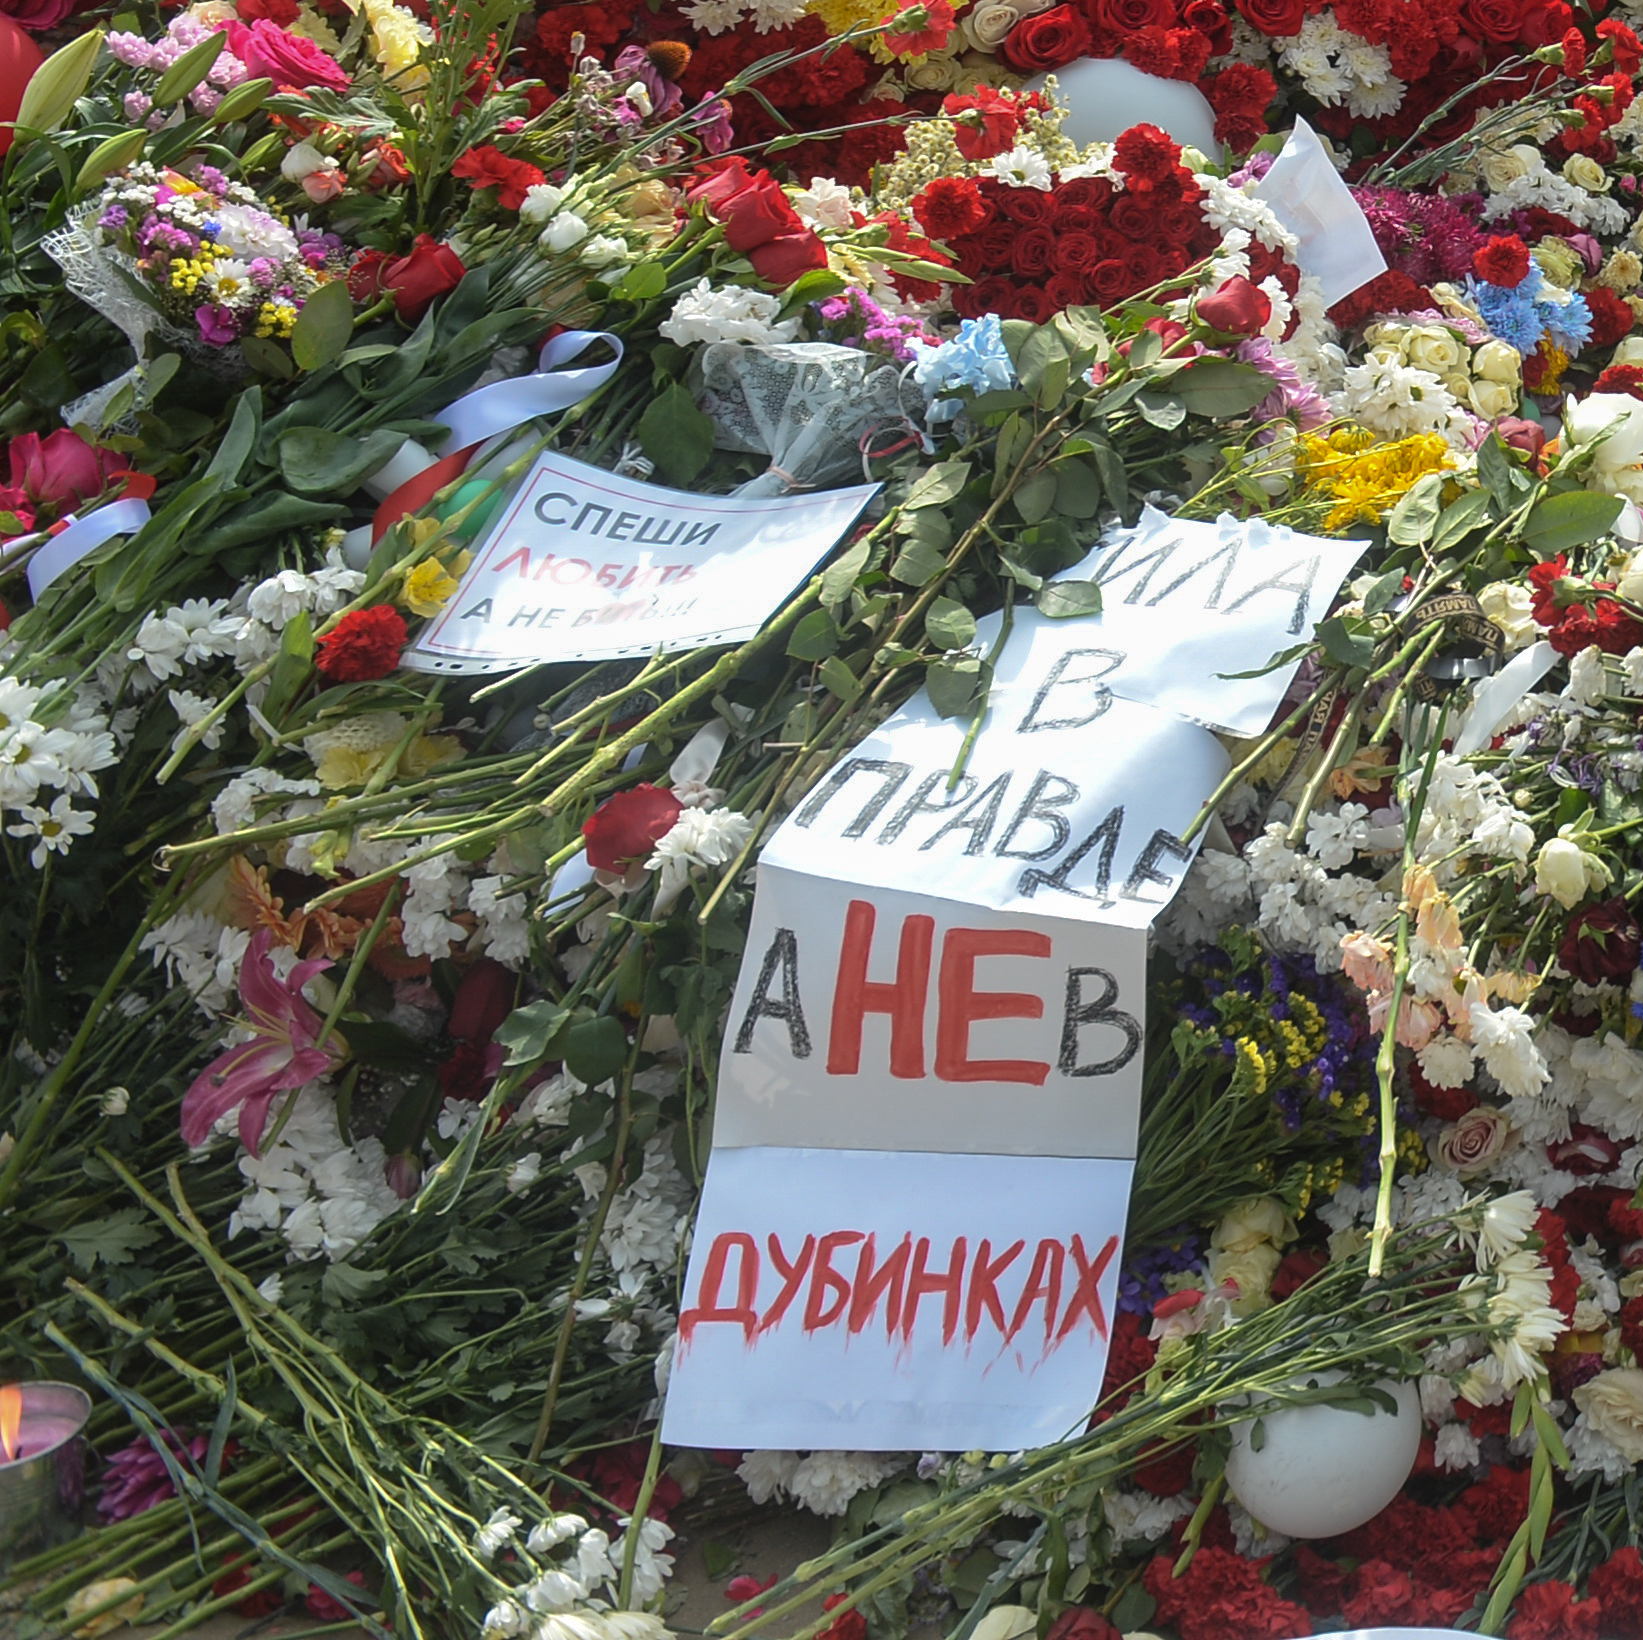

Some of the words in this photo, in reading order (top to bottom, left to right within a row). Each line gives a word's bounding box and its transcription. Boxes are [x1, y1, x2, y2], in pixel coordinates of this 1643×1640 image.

[533, 491, 723, 548] СПЕШИ
[492, 546, 698, 591] ЛЮБИТЬ
[1097, 536, 1320, 636] ИЛА
[1415, 597, 1478, 621] ПАМЯТЬ
[461, 597, 494, 624] А
[507, 604, 566, 630] НЕ
[1016, 648, 1128, 735] В
[795, 757, 1193, 910] ПРАВДЕ
[732, 927, 813, 1059] А
[826, 898, 1052, 1086] НЕ
[1057, 964, 1144, 1078] В
[677, 1230, 1120, 1355] ДУБИНКАХ
